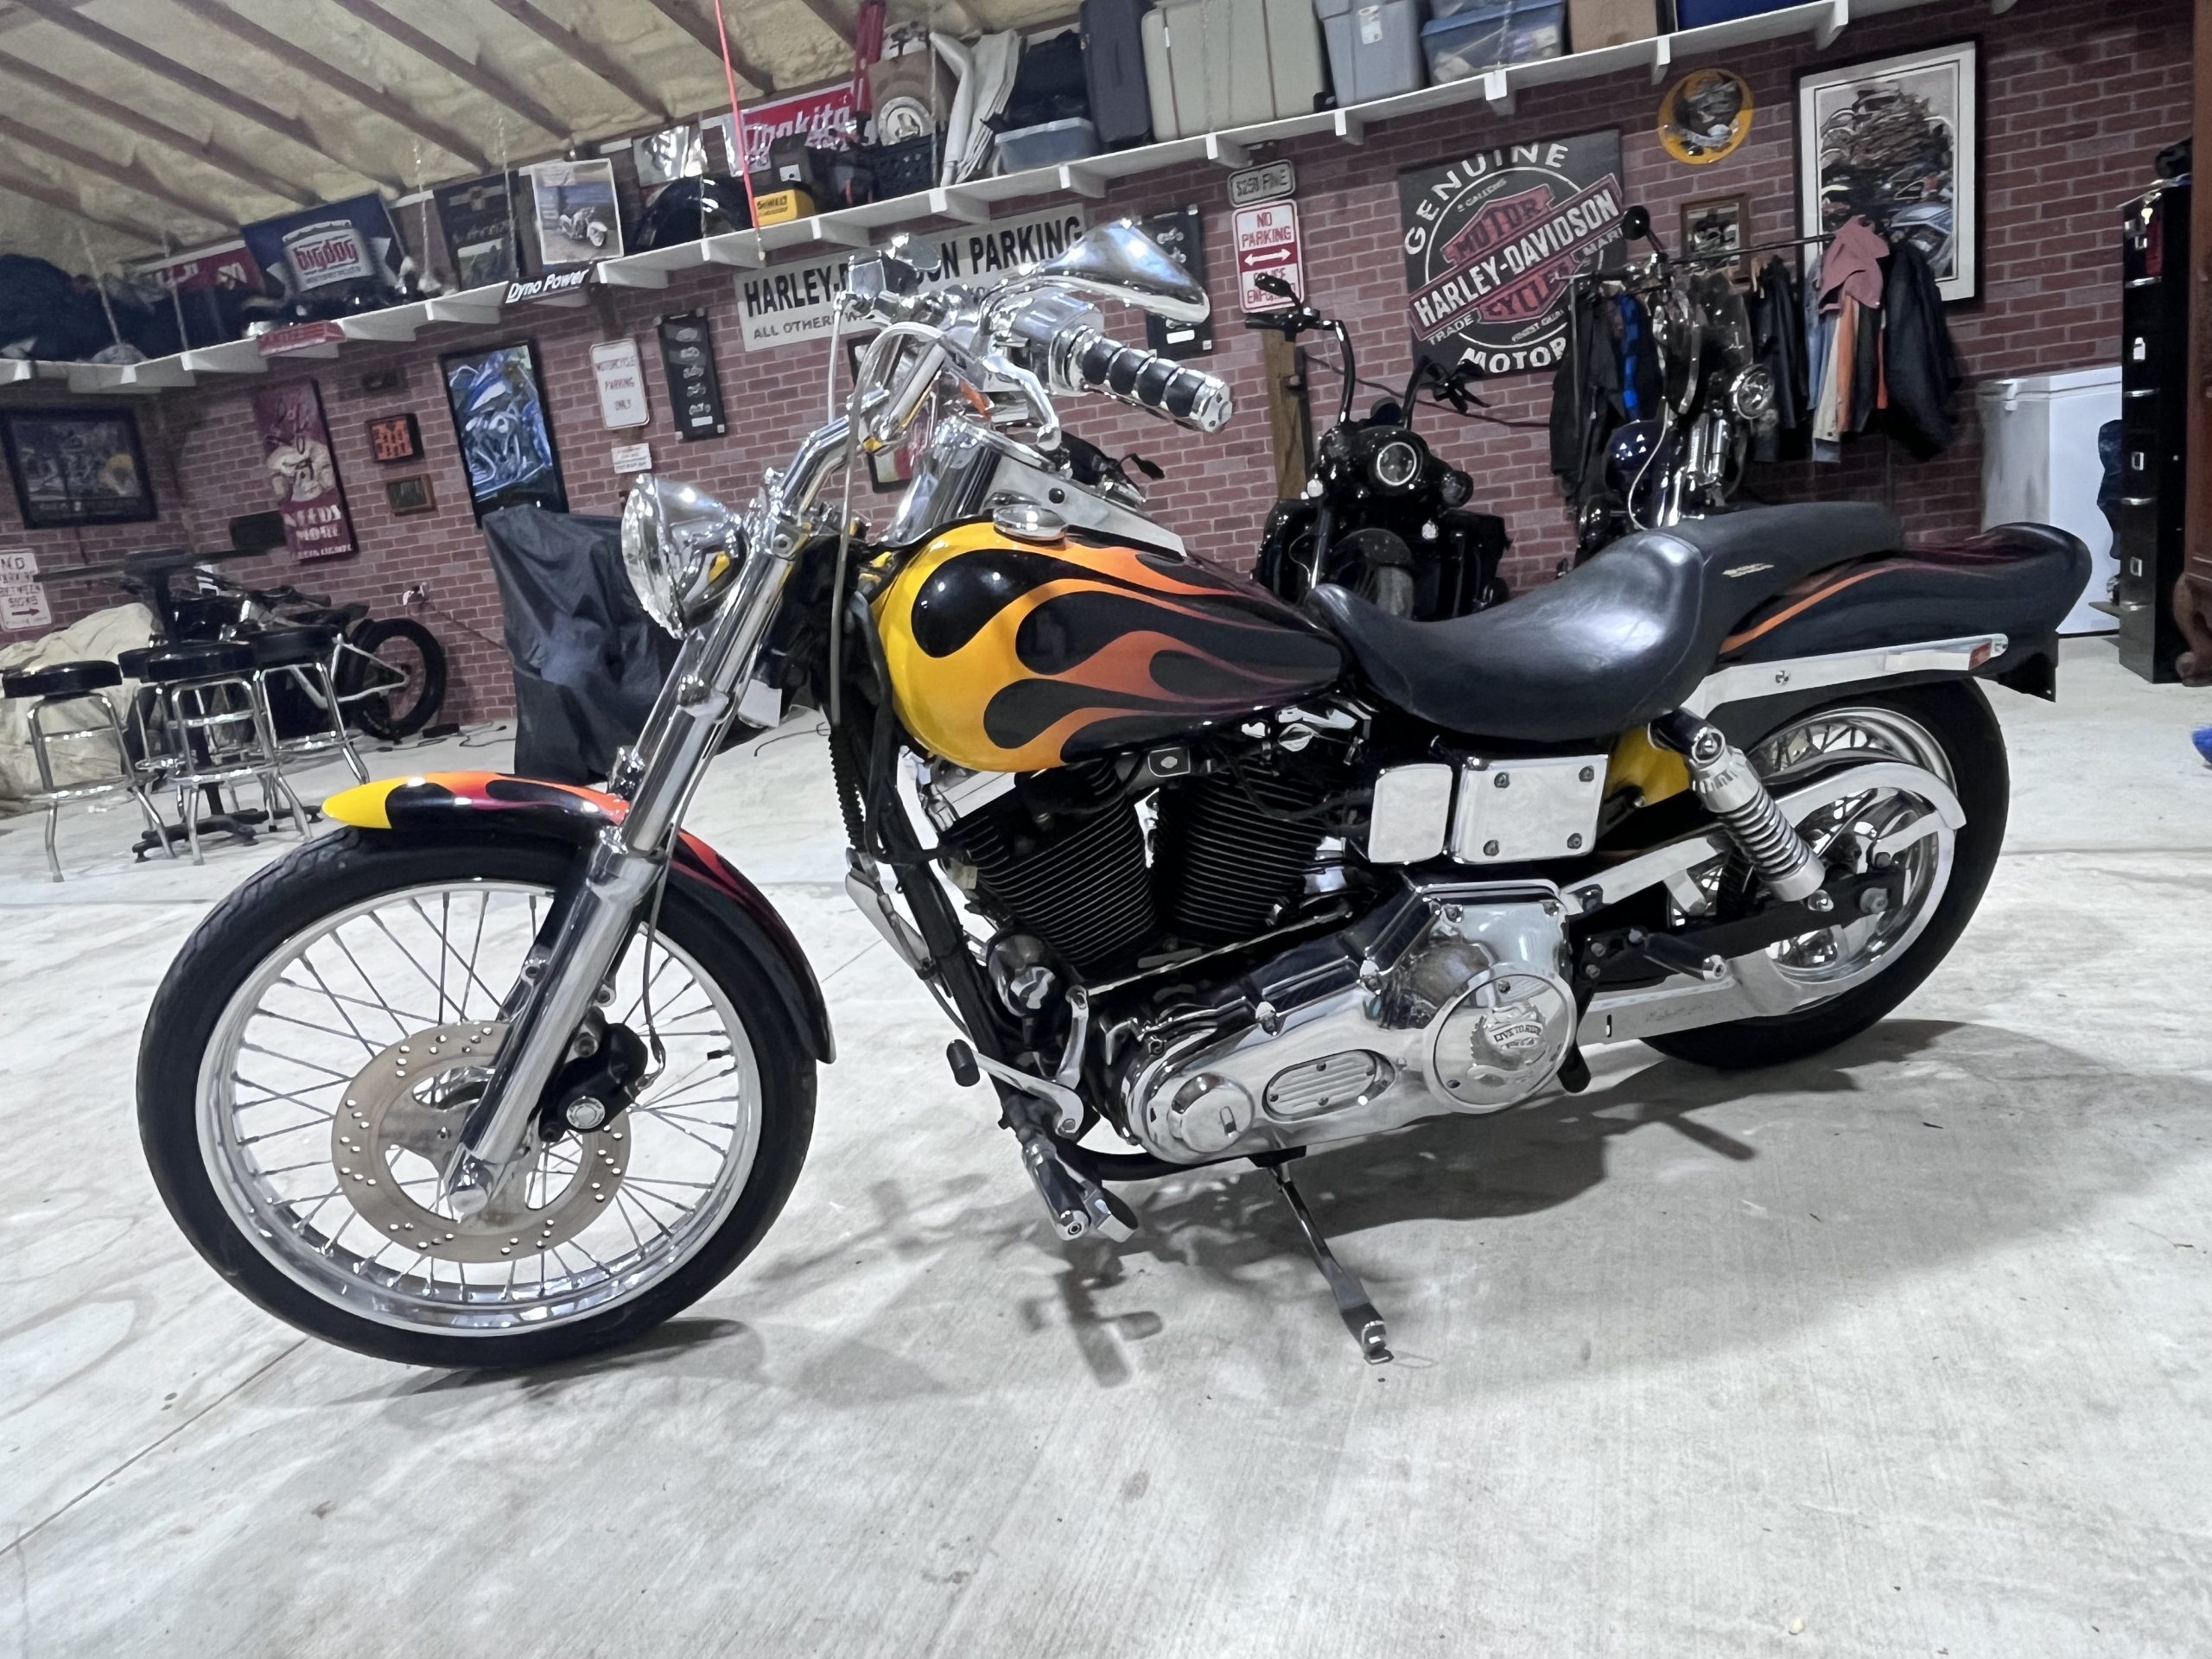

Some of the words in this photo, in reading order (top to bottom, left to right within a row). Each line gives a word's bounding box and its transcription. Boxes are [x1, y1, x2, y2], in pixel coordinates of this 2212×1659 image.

[1404, 143, 1568, 256] GENUINE
[1242, 226, 1292, 248] PARKING
[1257, 212, 1272, 228] NO
[1456, 198, 1539, 261] MOTOR
[969, 216, 1083, 275] PARKING
[1413, 188, 1620, 328] HARLEY-DAVIDSON
[505, 281, 543, 304] Dyno
[543, 267, 589, 292] Power
[753, 325, 779, 340] ALL
[1427, 313, 1475, 346] TRADE
